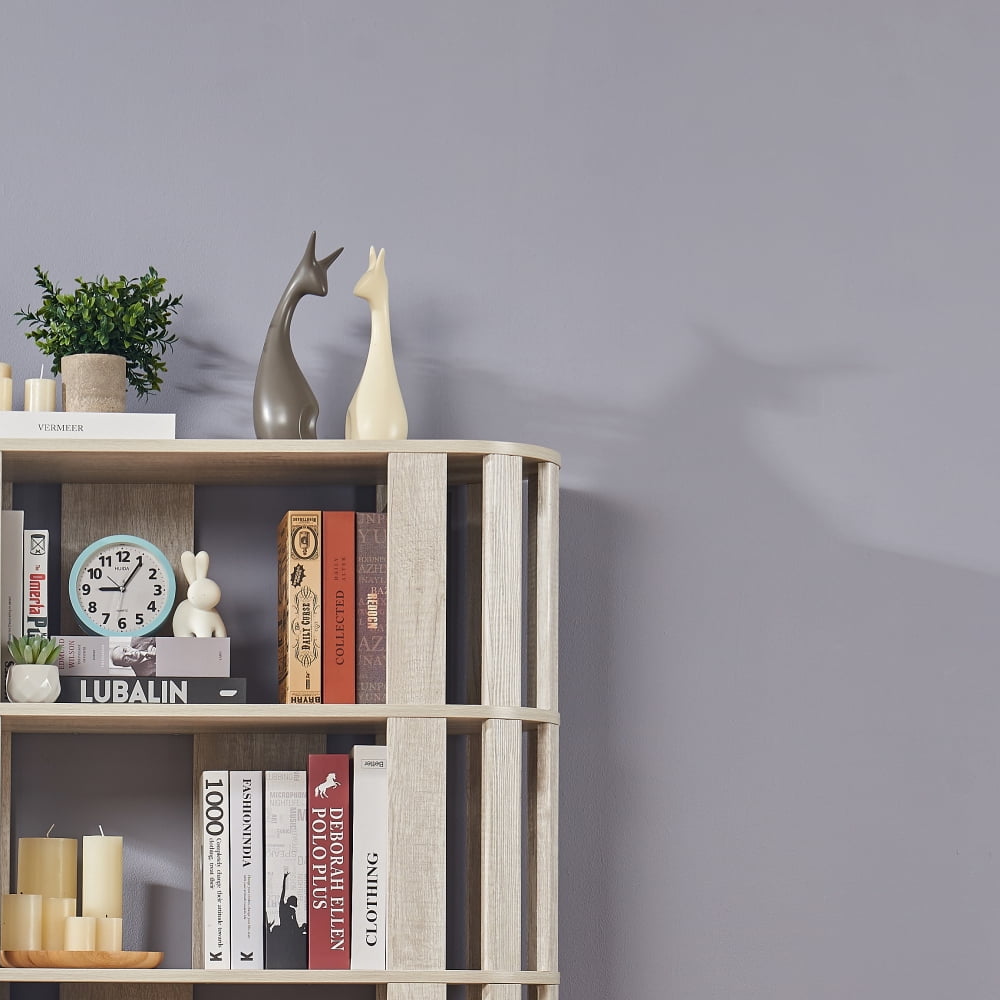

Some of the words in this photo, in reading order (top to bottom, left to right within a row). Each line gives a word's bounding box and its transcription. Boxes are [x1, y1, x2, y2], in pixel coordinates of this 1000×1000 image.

[38, 423, 84, 432] VERMEER
[99, 555, 112, 567] 11
[116, 551, 131, 563] 12
[136, 555, 143, 567] 1
[87, 568, 102, 579] 10
[148, 568, 157, 580] 2
[28, 573, 46, 615] Omerta
[82, 584, 91, 595] 9
[153, 584, 162, 596] 3
[88, 601, 97, 613] 8
[146, 600, 157, 612] 4
[101, 612, 110, 624] 7
[135, 613, 144, 625] 5
[301, 602, 310, 626] CURSE
[117, 617, 127, 629] 6
[335, 590, 345, 666] COLLECTED
[301, 627, 311, 650] DAILY
[68, 640, 76, 669] WILSON
[80, 679, 189, 704] LUBALIN
[364, 759, 384, 769] Better
[205, 778, 225, 836] 1000
[311, 808, 327, 860] POLO
[329, 807, 344, 891] DEBORAH
[312, 864, 327, 910] PLUS
[365, 852, 379, 947] CLOTHING
[330, 896, 345, 951] ELLEN
[209, 951, 223, 962] K
[240, 951, 254, 962] K
